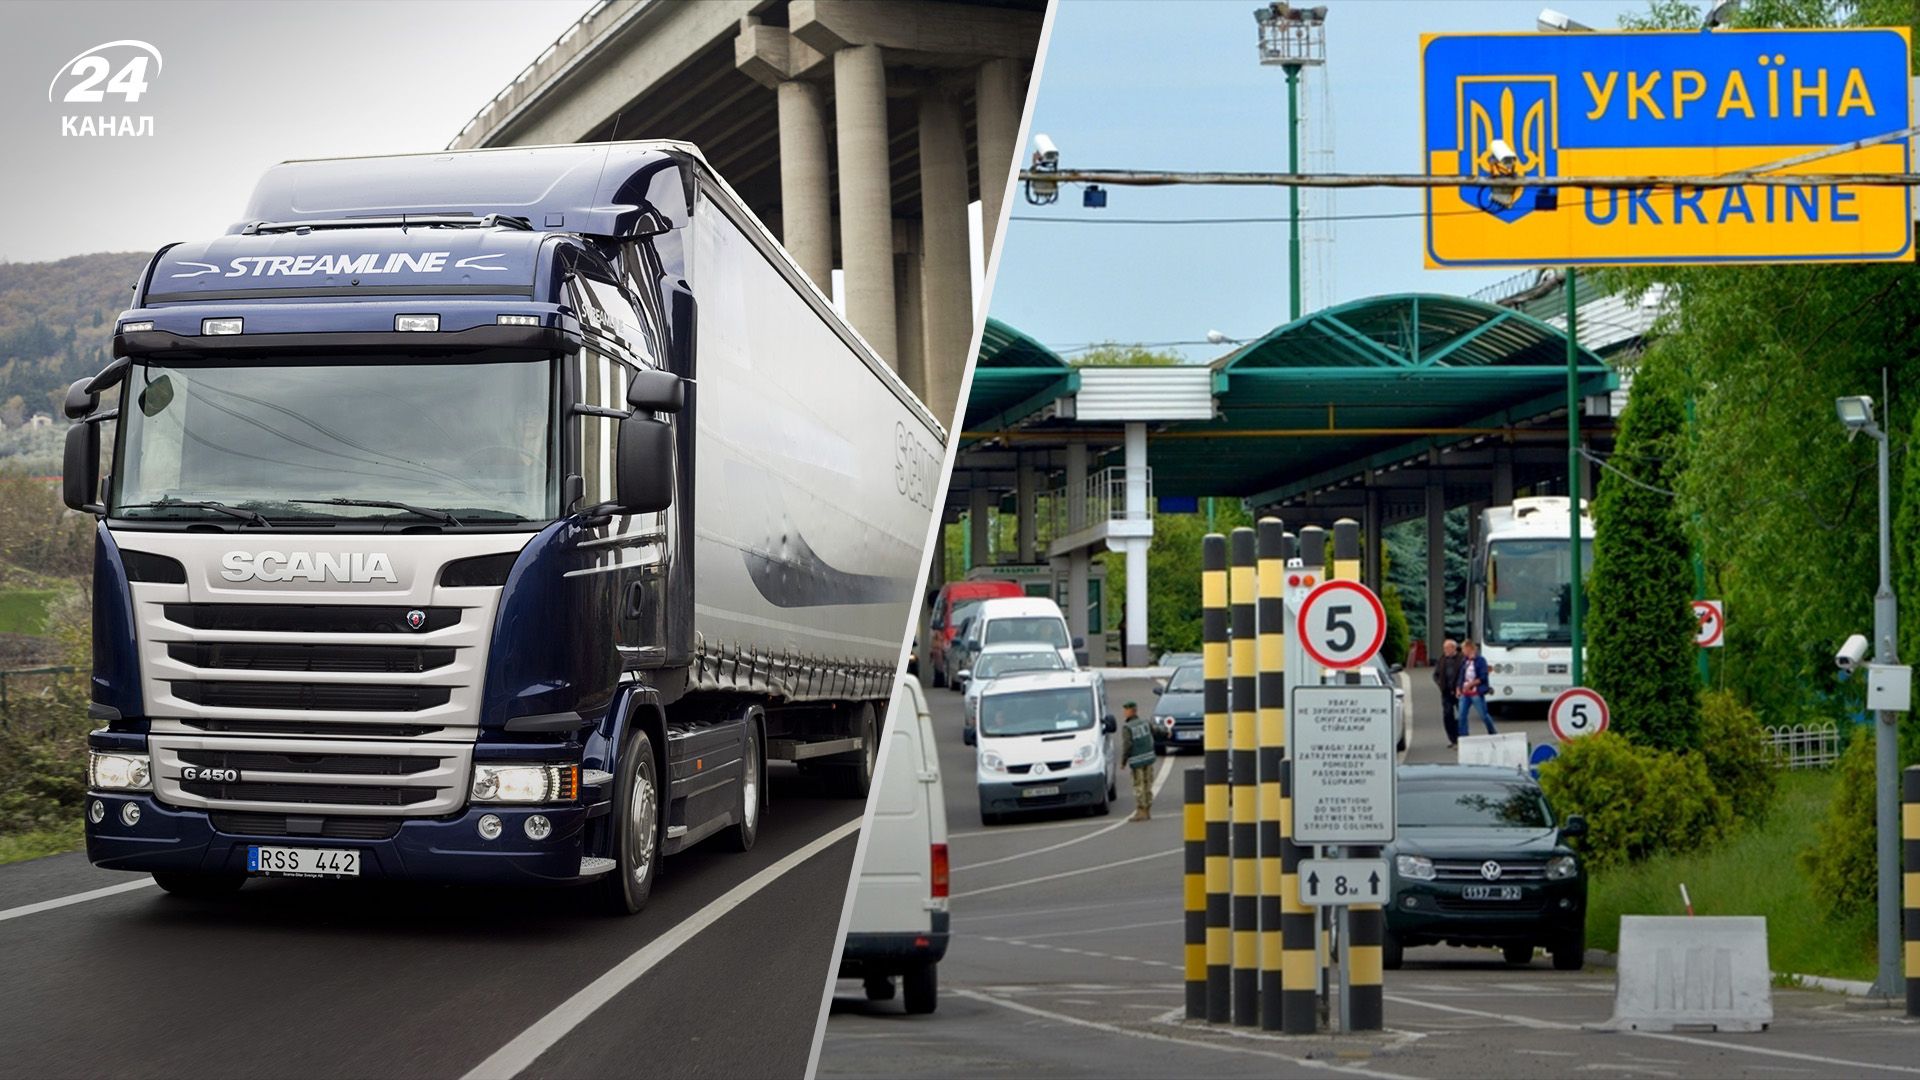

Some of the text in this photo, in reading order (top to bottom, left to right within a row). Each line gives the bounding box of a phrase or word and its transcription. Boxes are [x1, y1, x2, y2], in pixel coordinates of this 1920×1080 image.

[1581, 54, 1876, 120] УКРАЇНА
[1583, 183, 1860, 225] UKRAINE
[225, 252, 450, 277] STREAMLINE
[220, 551, 398, 583] SCANIA
[1326, 605, 1356, 652] 5
[1571, 704, 1588, 729] 5
[184, 768, 237, 781] G 450
[261, 850, 354, 872] RSS 442
